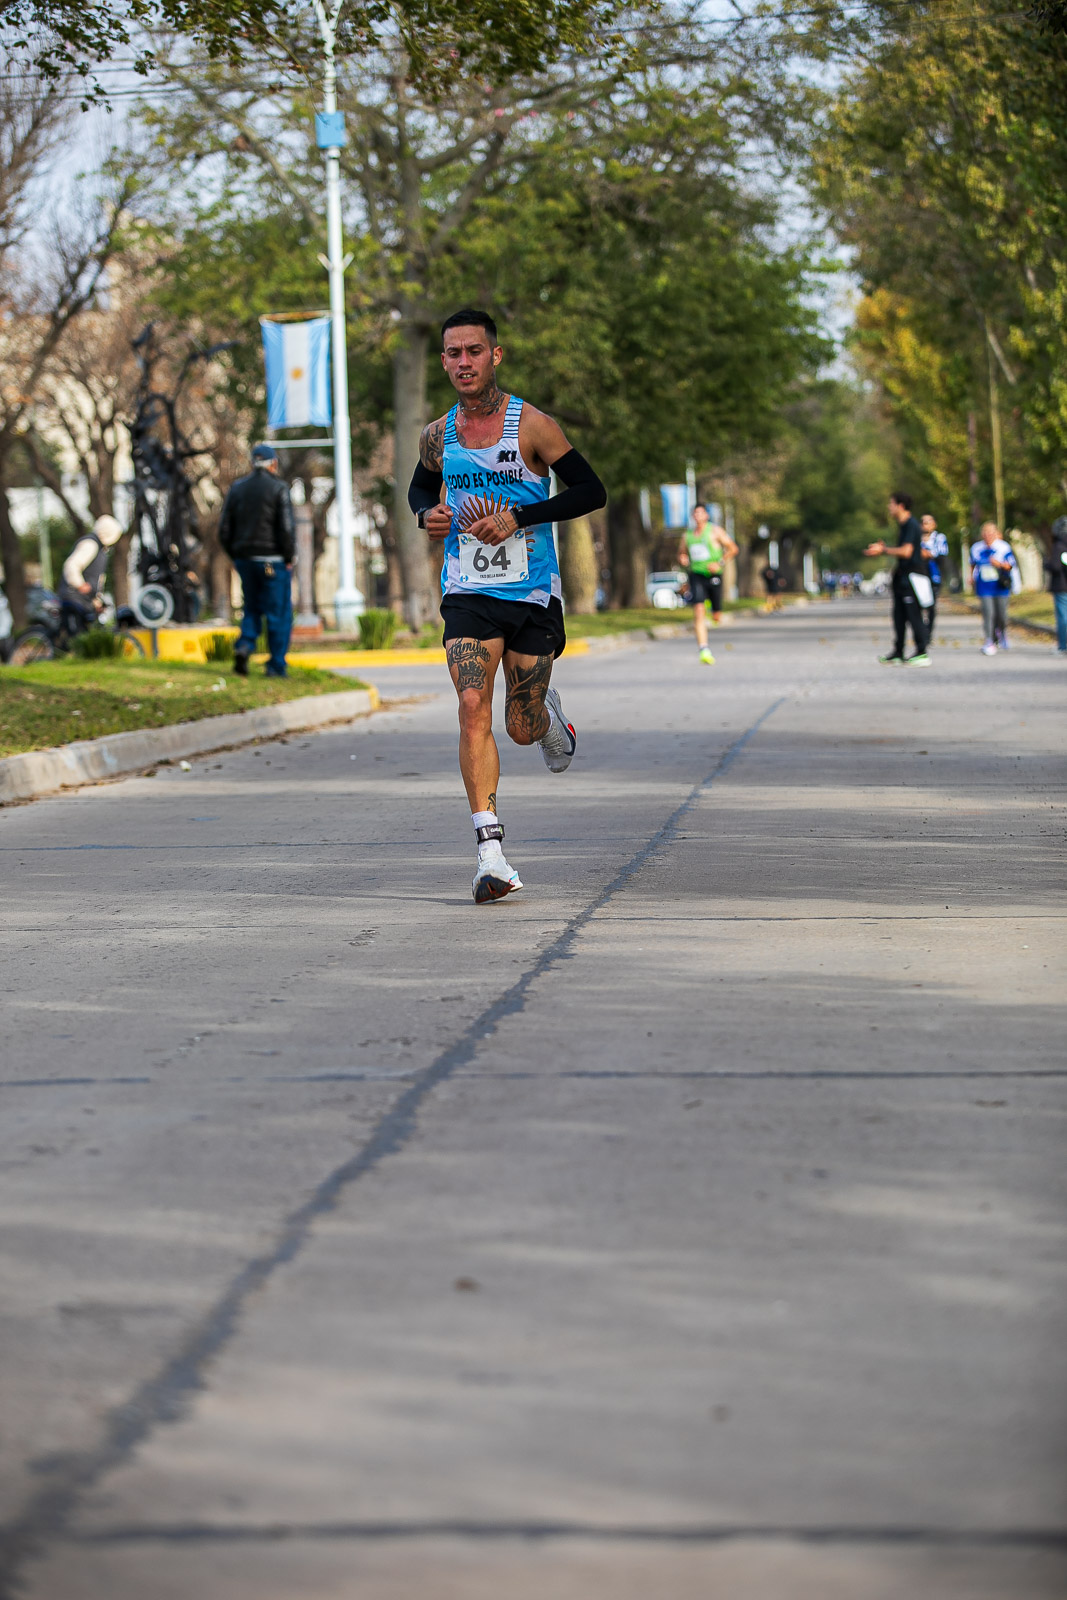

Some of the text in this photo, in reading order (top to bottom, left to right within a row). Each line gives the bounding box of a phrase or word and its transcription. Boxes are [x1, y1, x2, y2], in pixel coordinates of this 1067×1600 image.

[473, 472, 483, 488] ES
[486, 468, 523, 487] POSIBLE
[473, 546, 511, 572] 64
